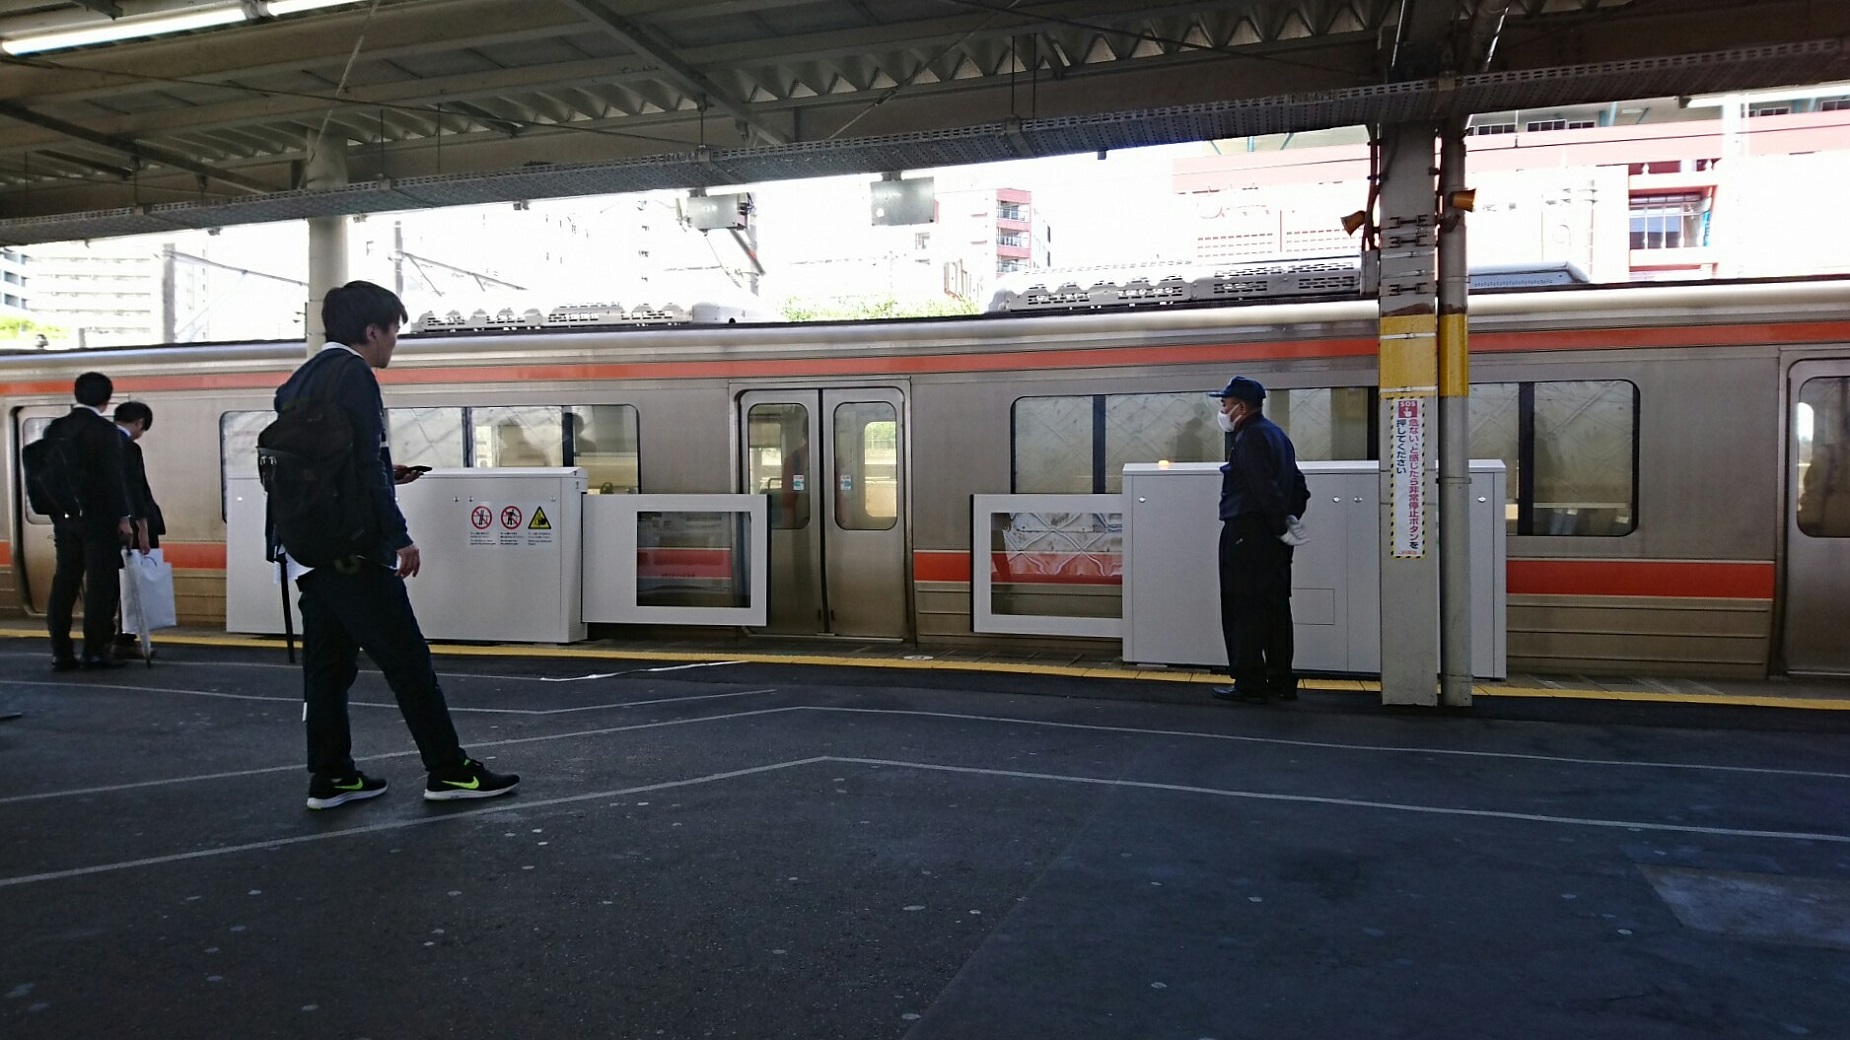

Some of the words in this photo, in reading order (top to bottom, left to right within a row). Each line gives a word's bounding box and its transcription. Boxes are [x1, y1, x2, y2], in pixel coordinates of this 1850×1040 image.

[1396, 419, 1407, 474] 押してください
